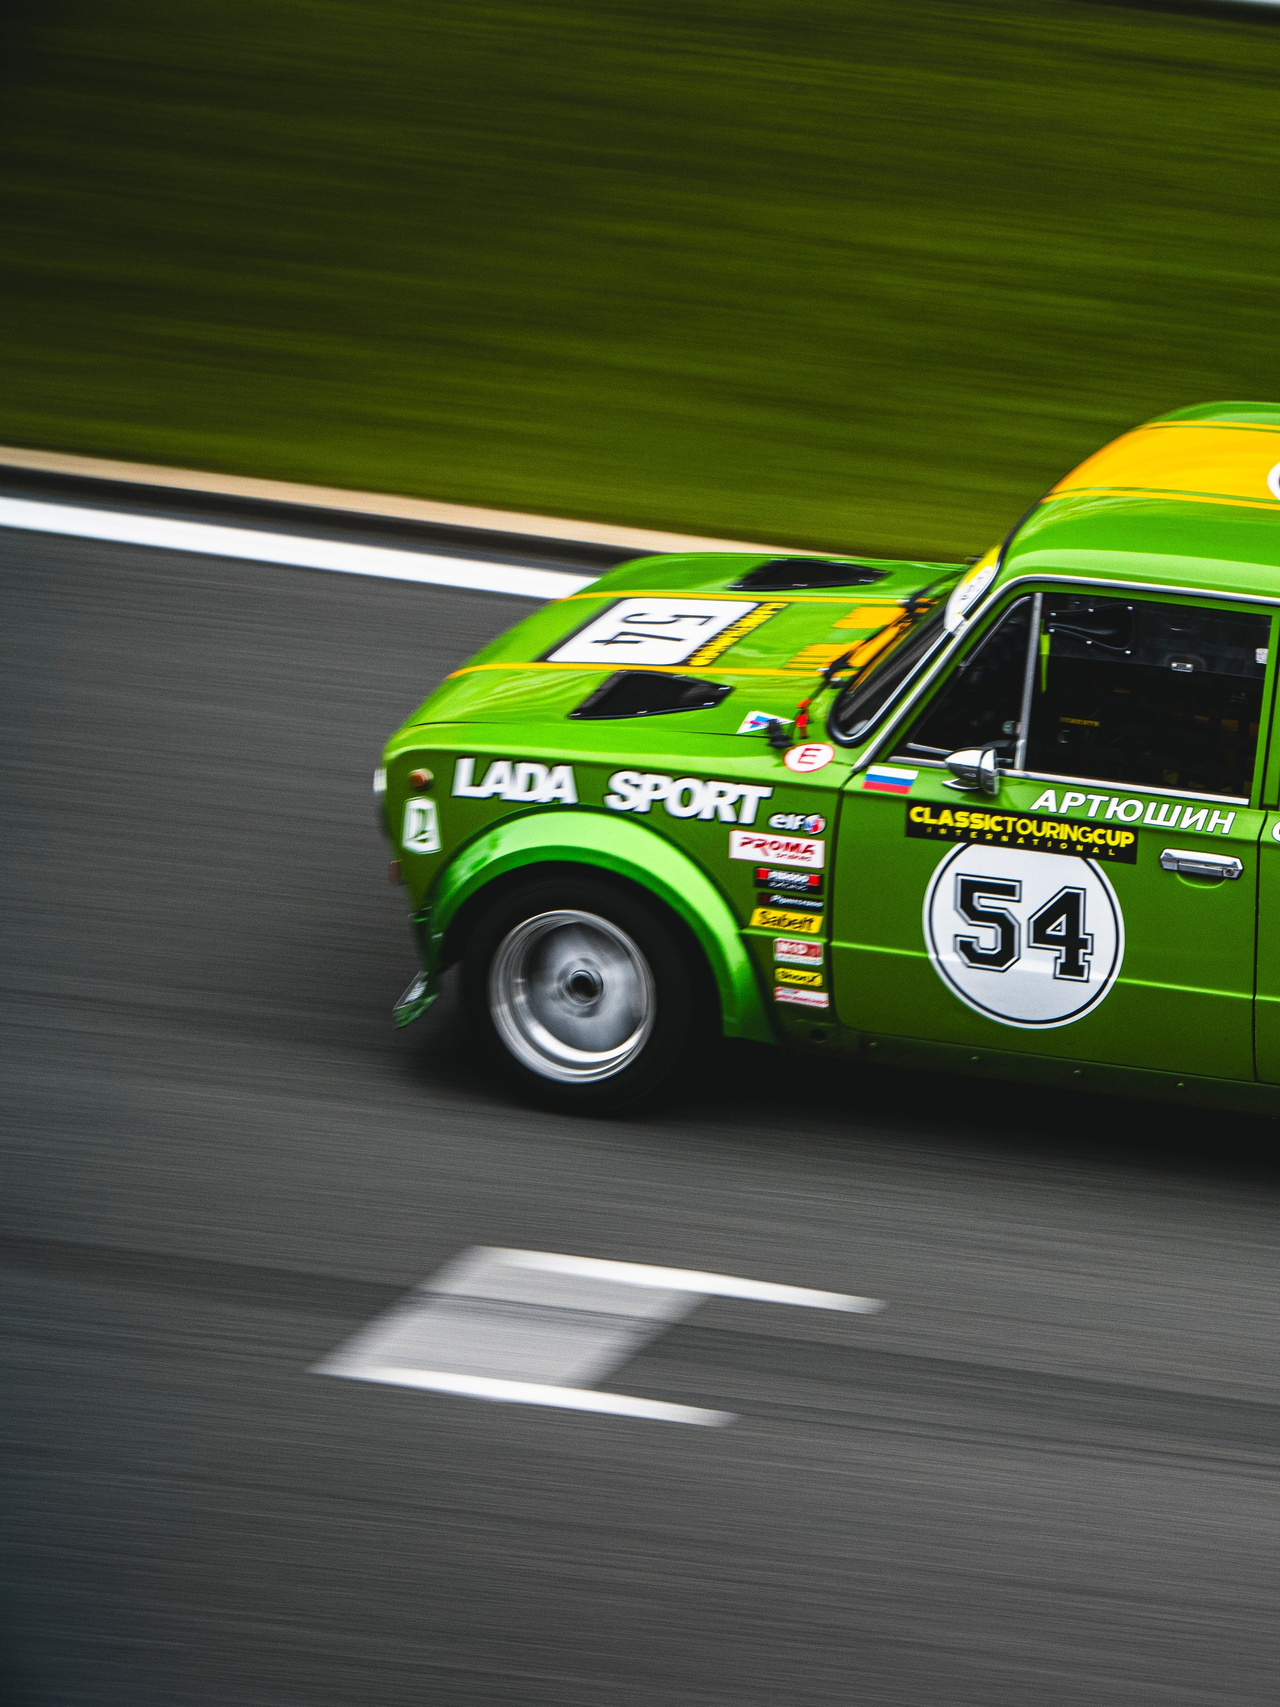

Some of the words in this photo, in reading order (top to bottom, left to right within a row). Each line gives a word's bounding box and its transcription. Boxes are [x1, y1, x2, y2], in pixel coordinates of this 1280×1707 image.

[591, 613, 716, 646] 54
[797, 747, 822, 765] E
[452, 757, 578, 804] LADA
[604, 769, 773, 825] SPORT
[768, 812, 806, 832] elf
[1029, 788, 1236, 835] АРТЮШИН
[925, 826, 1115, 856] INTERNATIONAL
[952, 872, 1095, 984] 54
